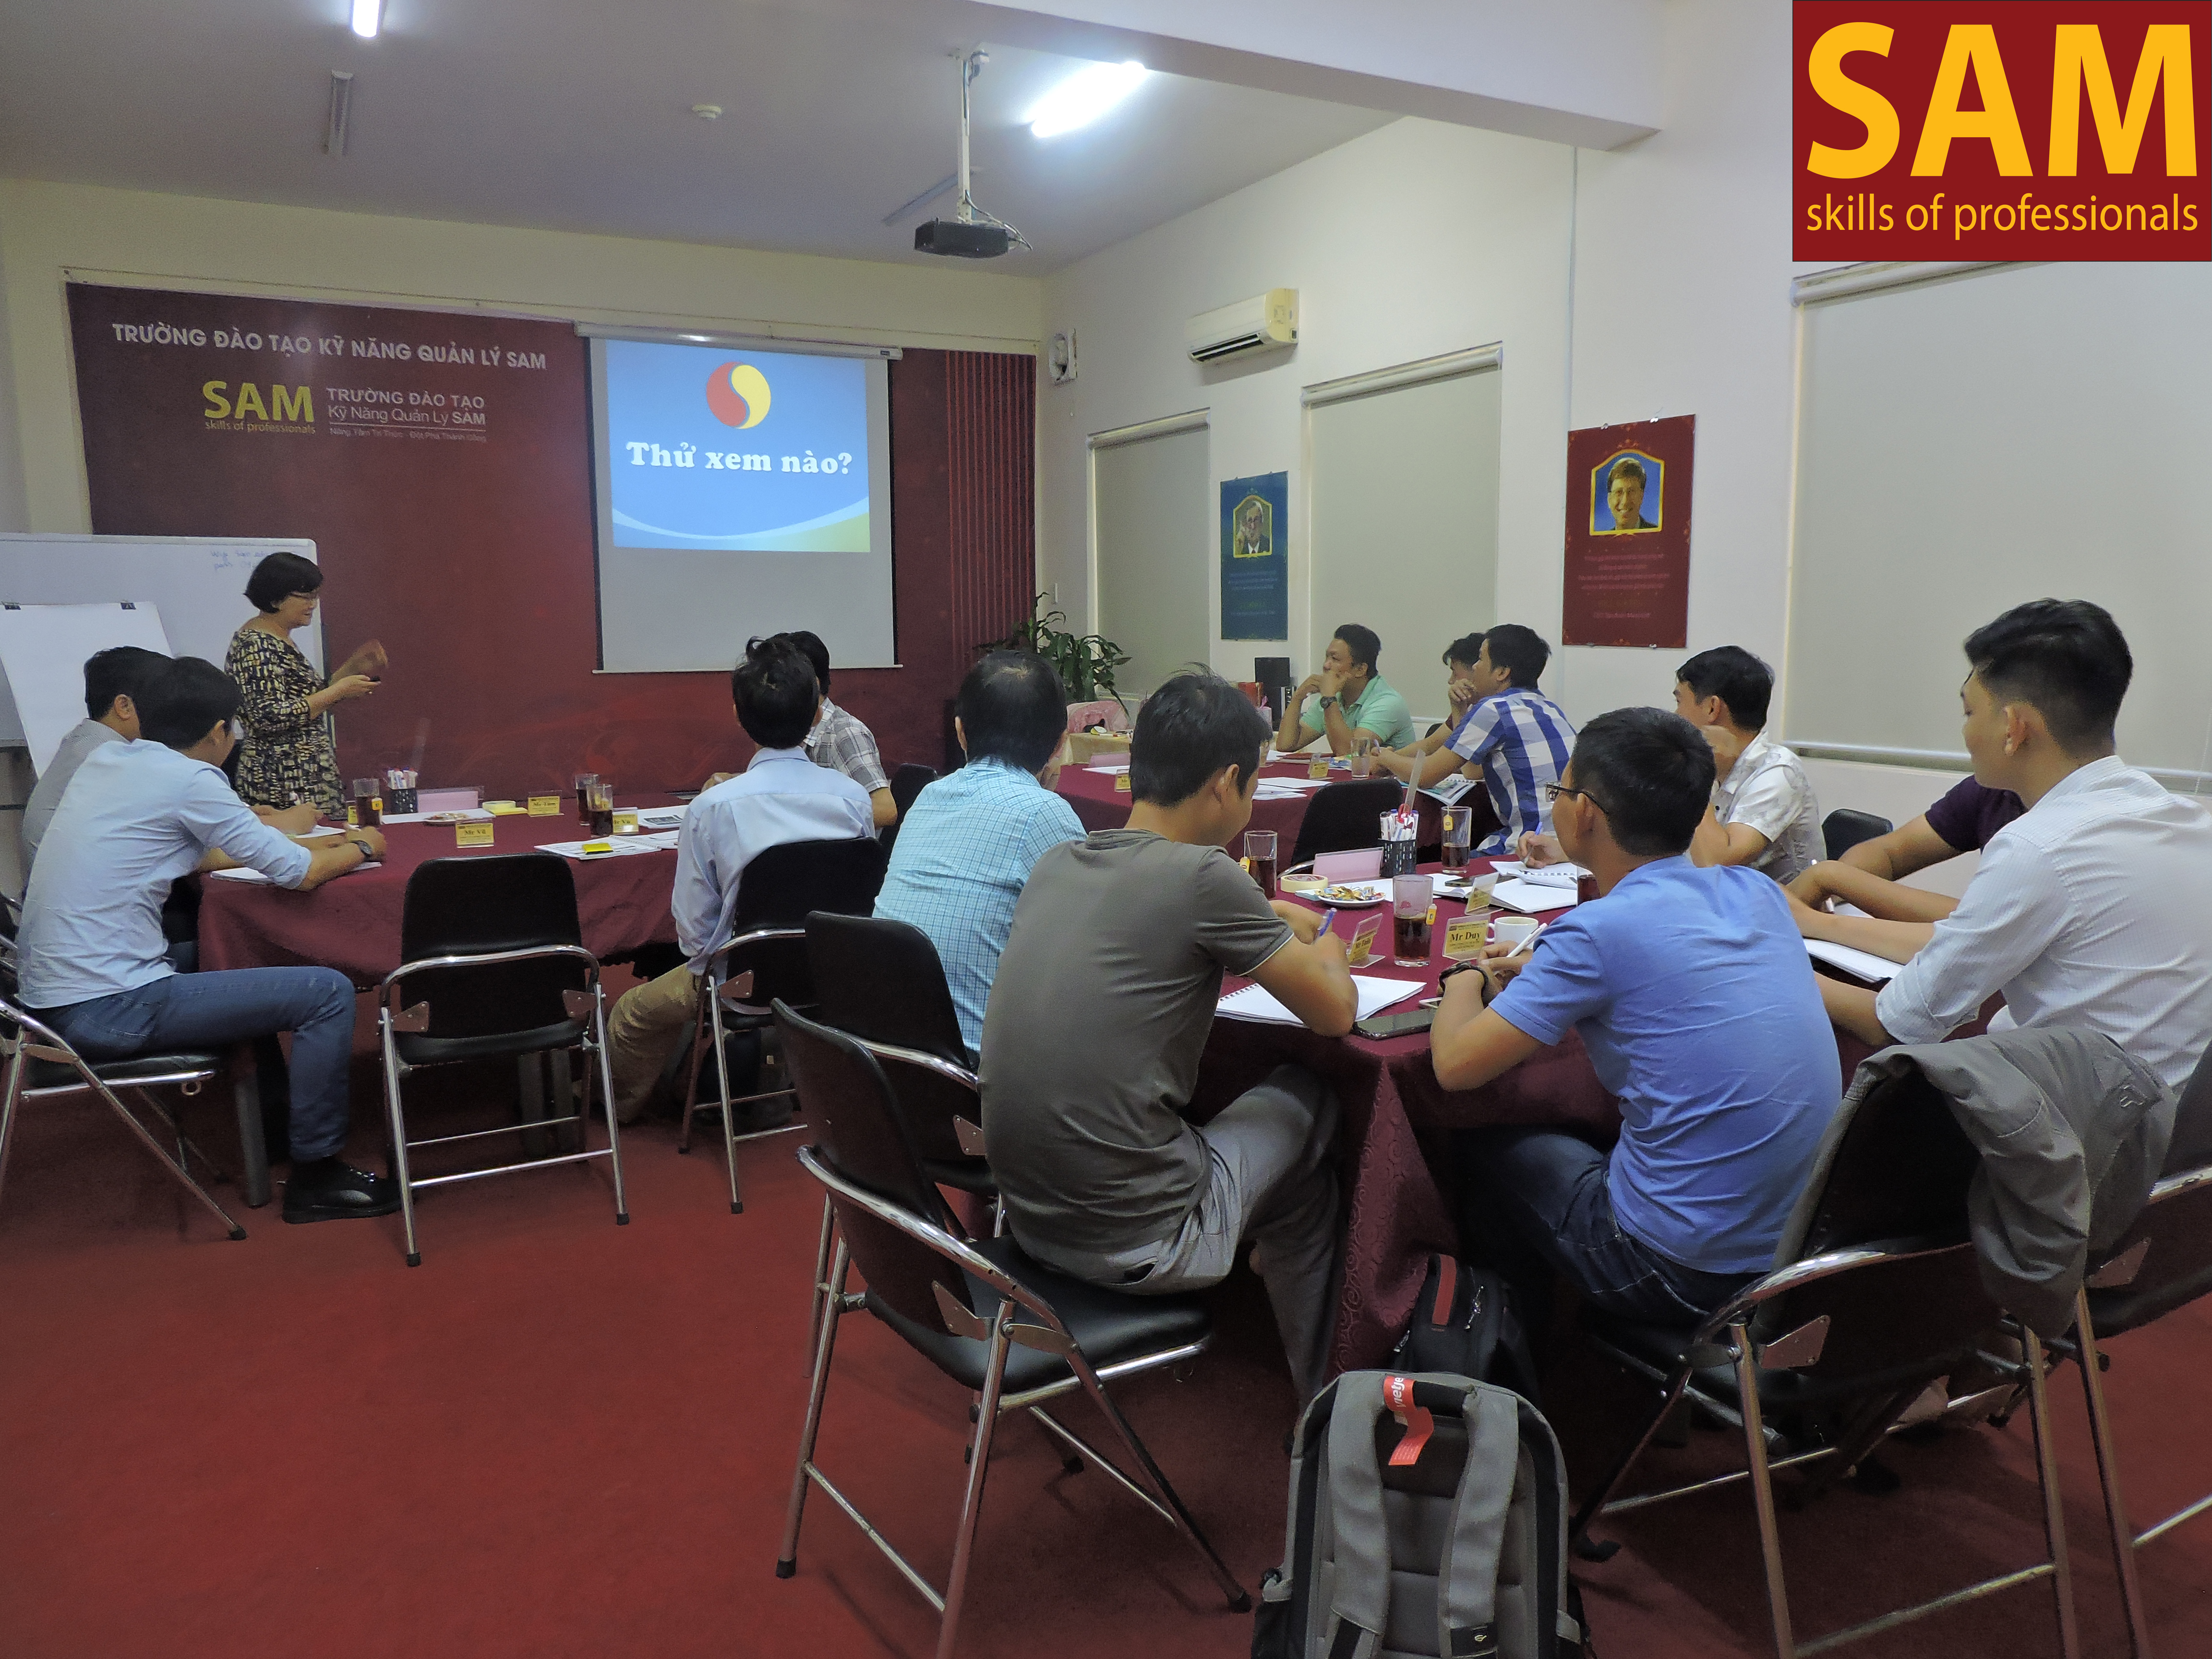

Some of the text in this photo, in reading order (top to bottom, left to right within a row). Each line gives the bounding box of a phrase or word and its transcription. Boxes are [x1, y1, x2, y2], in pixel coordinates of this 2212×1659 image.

[112, 321, 207, 348] TRƯỜNG
[214, 325, 263, 351] ĐÀO
[268, 333, 312, 358] TẠO
[318, 335, 344, 356] KỸ
[351, 336, 411, 361] NĂNG
[417, 340, 475, 365] QUẢN
[506, 351, 547, 370] SAM
[203, 380, 314, 422] SAM
[326, 387, 485, 411] TRƯỜNG ĐÀO TẠO
[205, 419, 315, 434] skills of professionals
[351, 406, 388, 423] Năng
[452, 411, 486, 426] SAM
[626, 441, 853, 475] Thử xem nào?
[1450, 932, 1481, 942] Mr Duy
